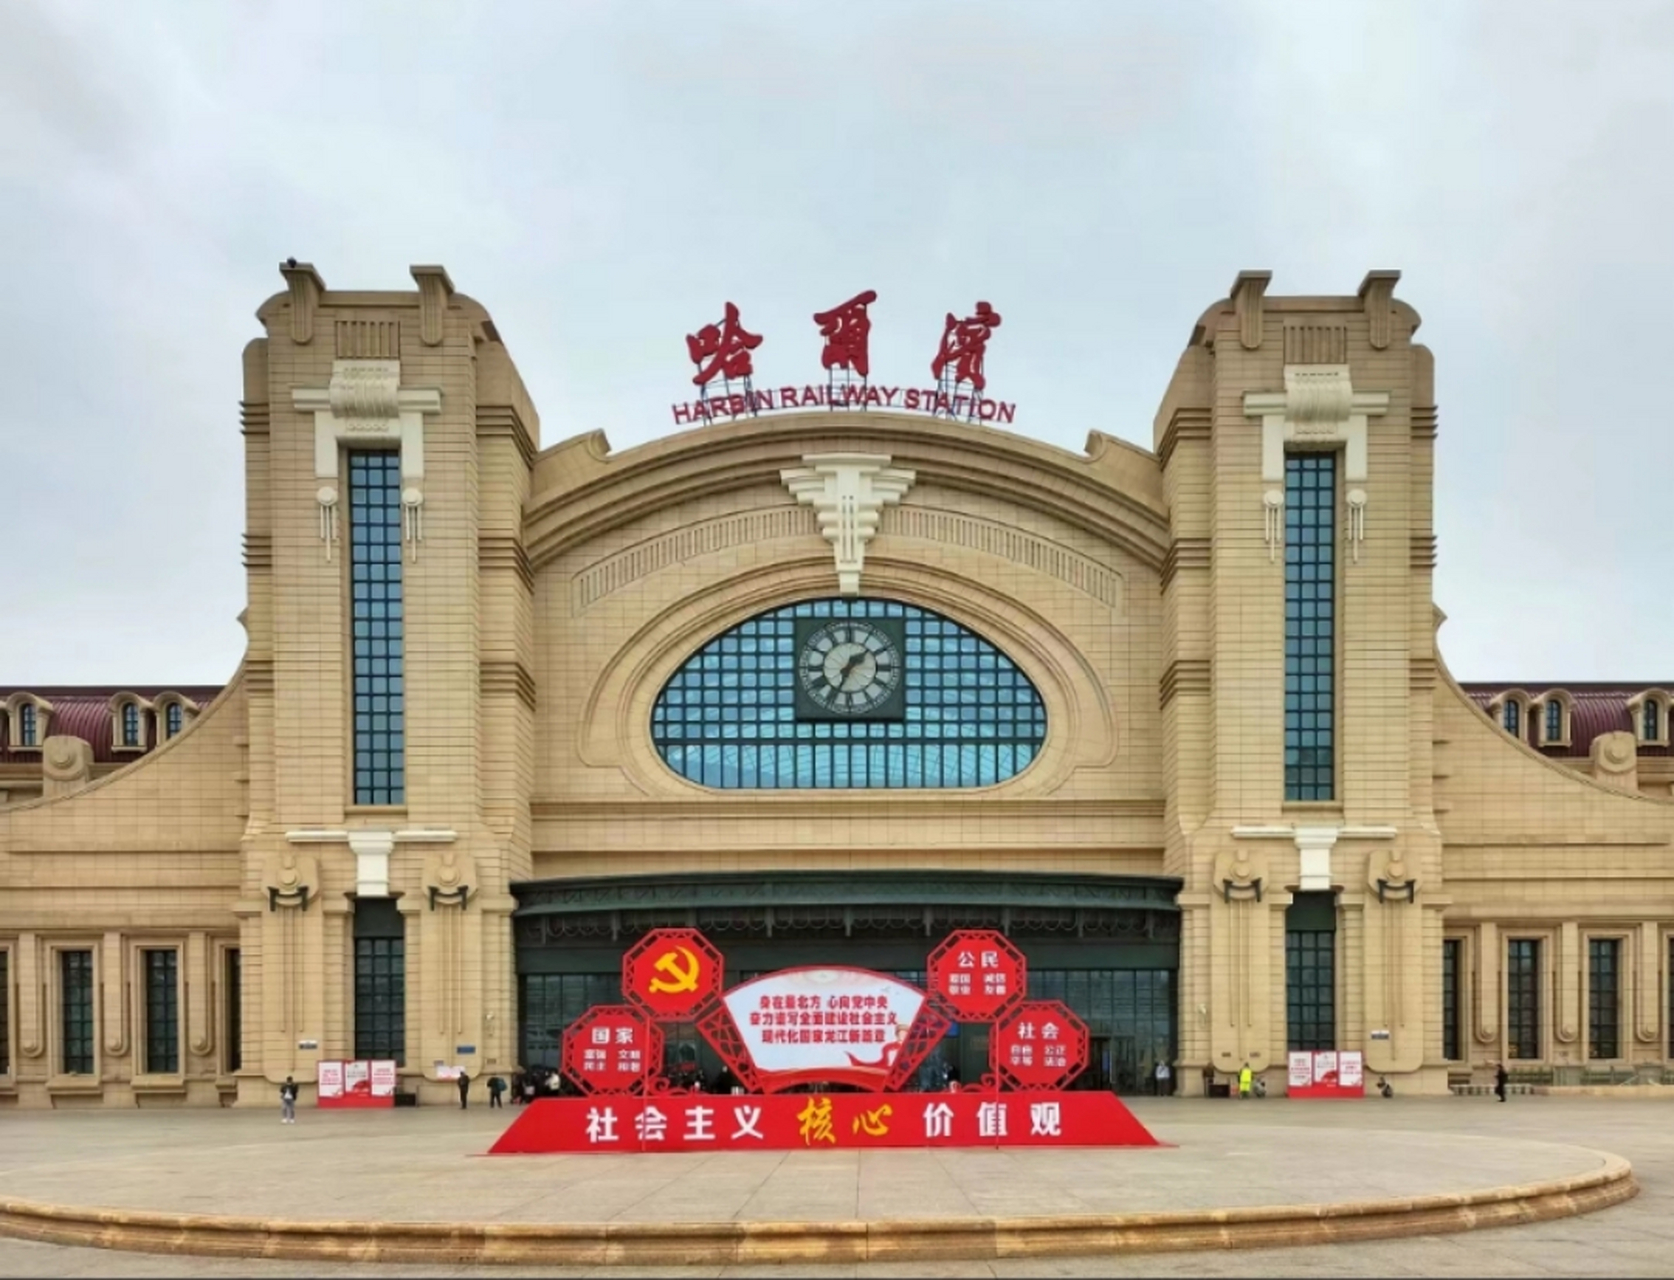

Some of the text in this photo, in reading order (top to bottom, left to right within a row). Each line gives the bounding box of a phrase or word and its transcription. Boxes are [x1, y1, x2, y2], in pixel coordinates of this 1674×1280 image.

[672, 384, 1016, 425] HARBIN RAILWAY STATION
[958, 951, 999, 968] 公民
[760, 995, 888, 1009] 身在最北方 心向党中央
[592, 1027, 633, 1044] 国家
[1018, 1022, 1060, 1039] 社会
[586, 1097, 1062, 1146] 社会主义 核心 价值观
